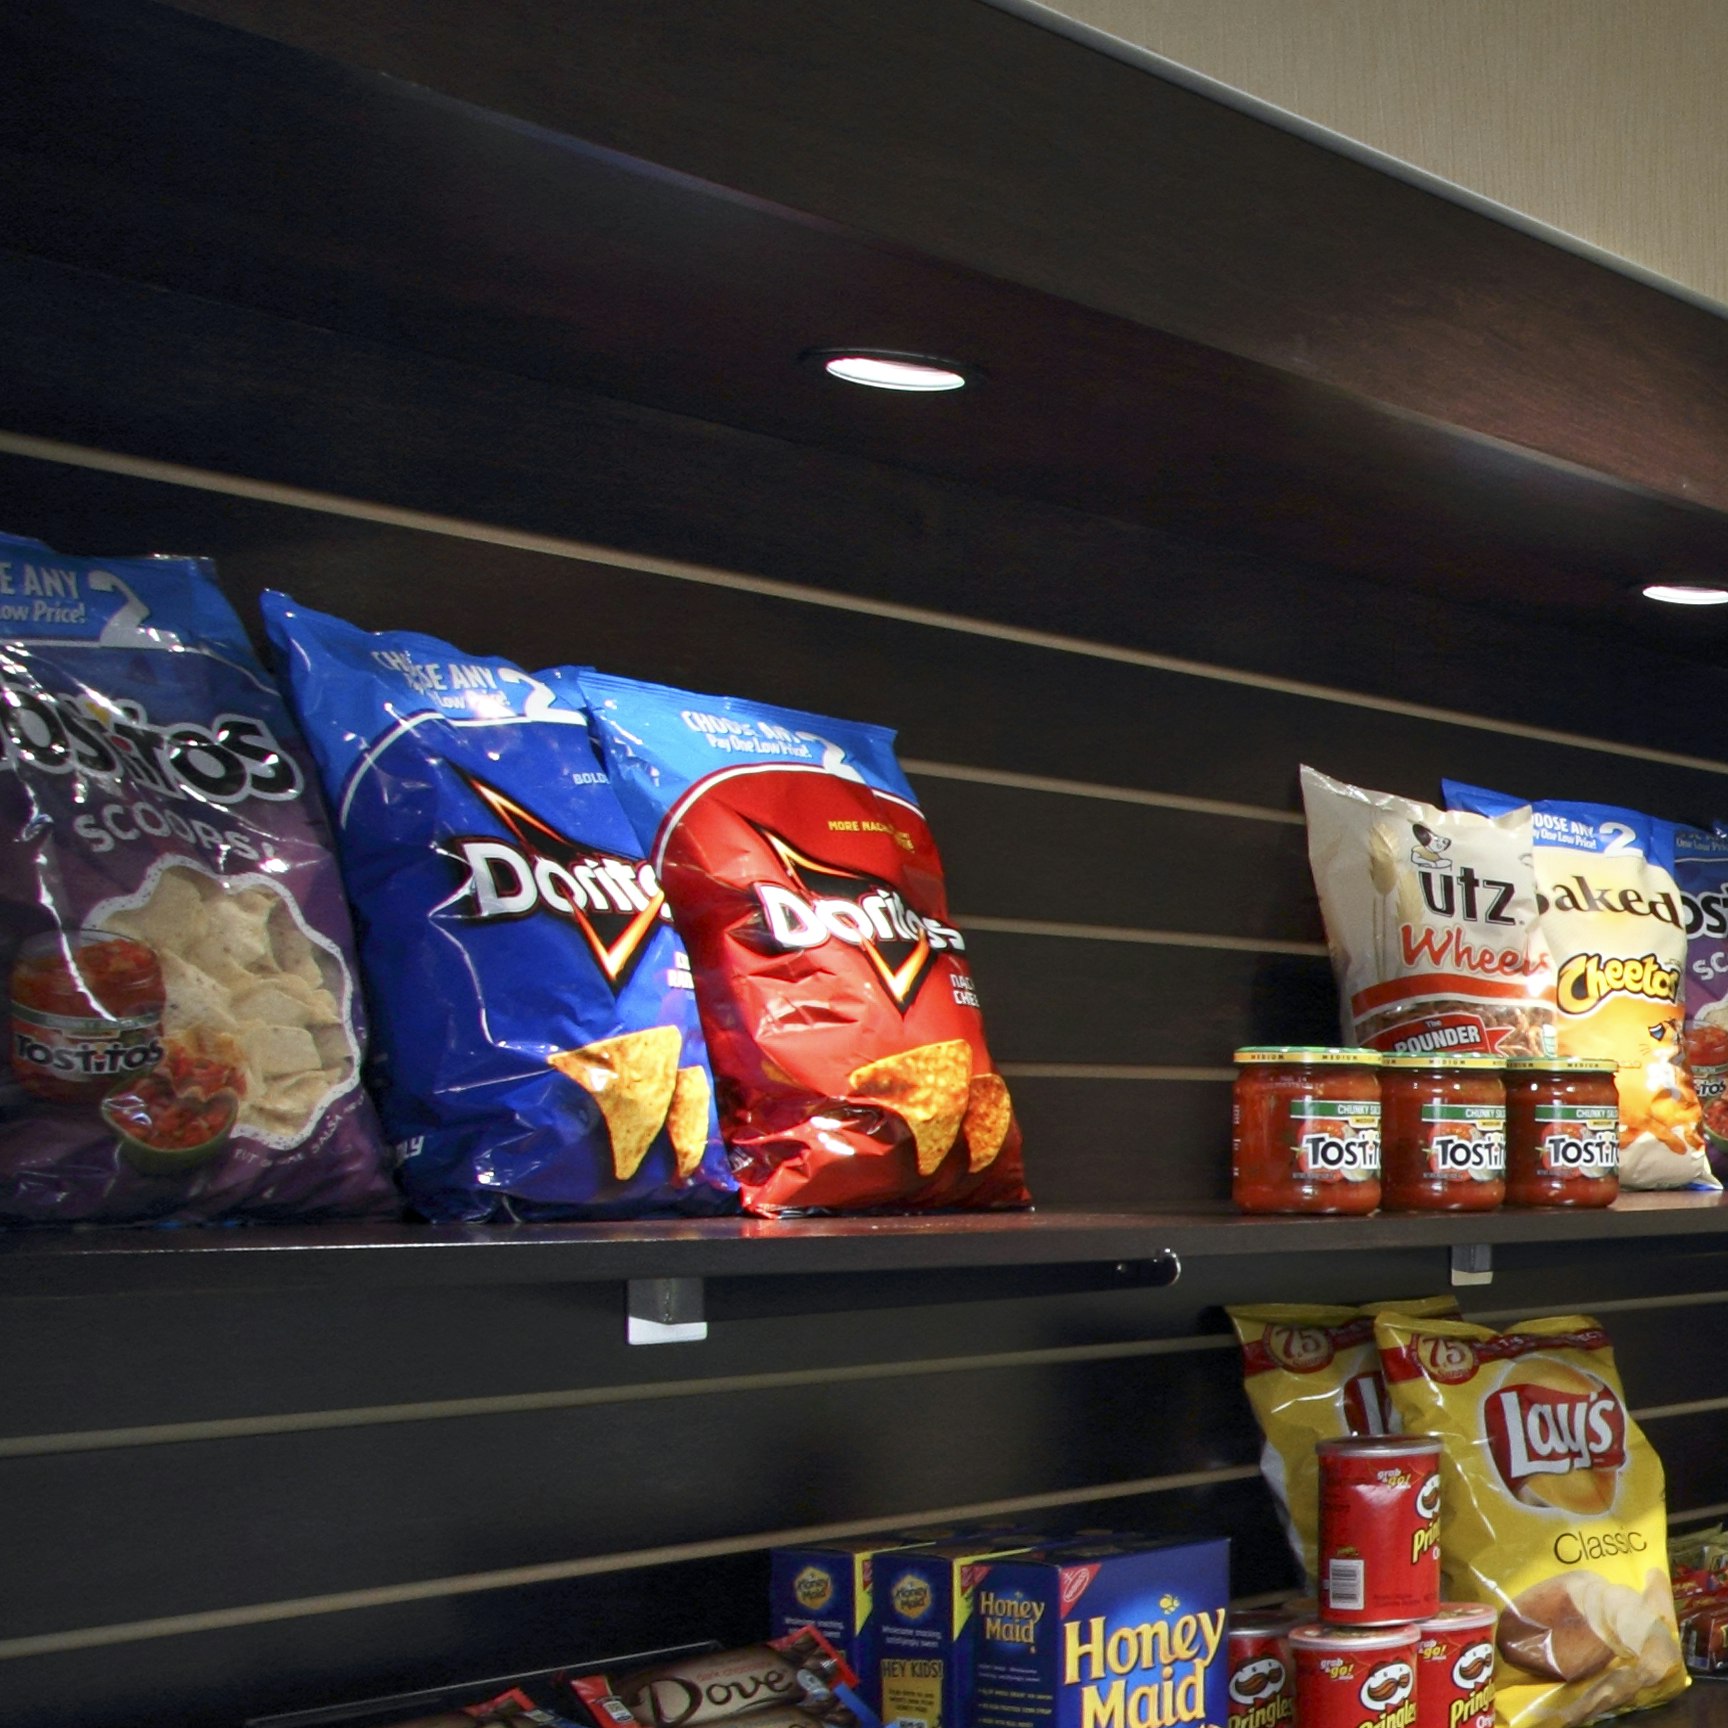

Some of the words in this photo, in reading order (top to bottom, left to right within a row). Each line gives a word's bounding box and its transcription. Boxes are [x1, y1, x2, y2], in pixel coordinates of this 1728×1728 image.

[24, 568, 79, 599] ANY
[33, 604, 85, 623] Price!
[451, 662, 498, 691] ANY
[0, 680, 303, 802] OSTITOS
[731, 738, 756, 754] One
[756, 741, 780, 757] Low
[828, 820, 859, 832] MORE
[1533, 813, 1567, 832] OOSE
[1557, 831, 1576, 846] Low
[462, 840, 672, 922] Dorito
[1418, 866, 1516, 926] utz
[754, 882, 965, 951] Doritos
[667, 969, 696, 990] RAN
[949, 972, 976, 989] NAC
[1394, 1024, 1481, 1054] POUNDER
[1337, 1104, 1370, 1116] CHUNKY
[1465, 1108, 1495, 1119] CHUNKY
[1576, 1109, 1605, 1119] CHUNKY
[1500, 1391, 1615, 1477] Lay's
[1553, 1527, 1649, 1565] Classic
[980, 1590, 1045, 1625] Honey
[985, 1616, 1035, 1644] Maid
[1063, 1607, 1226, 1687] Honey
[882, 1659, 908, 1678] HEY
[911, 1660, 943, 1680] KIDS!
[1320, 1657, 1343, 1670] grab
[1330, 1664, 1355, 1680] go!
